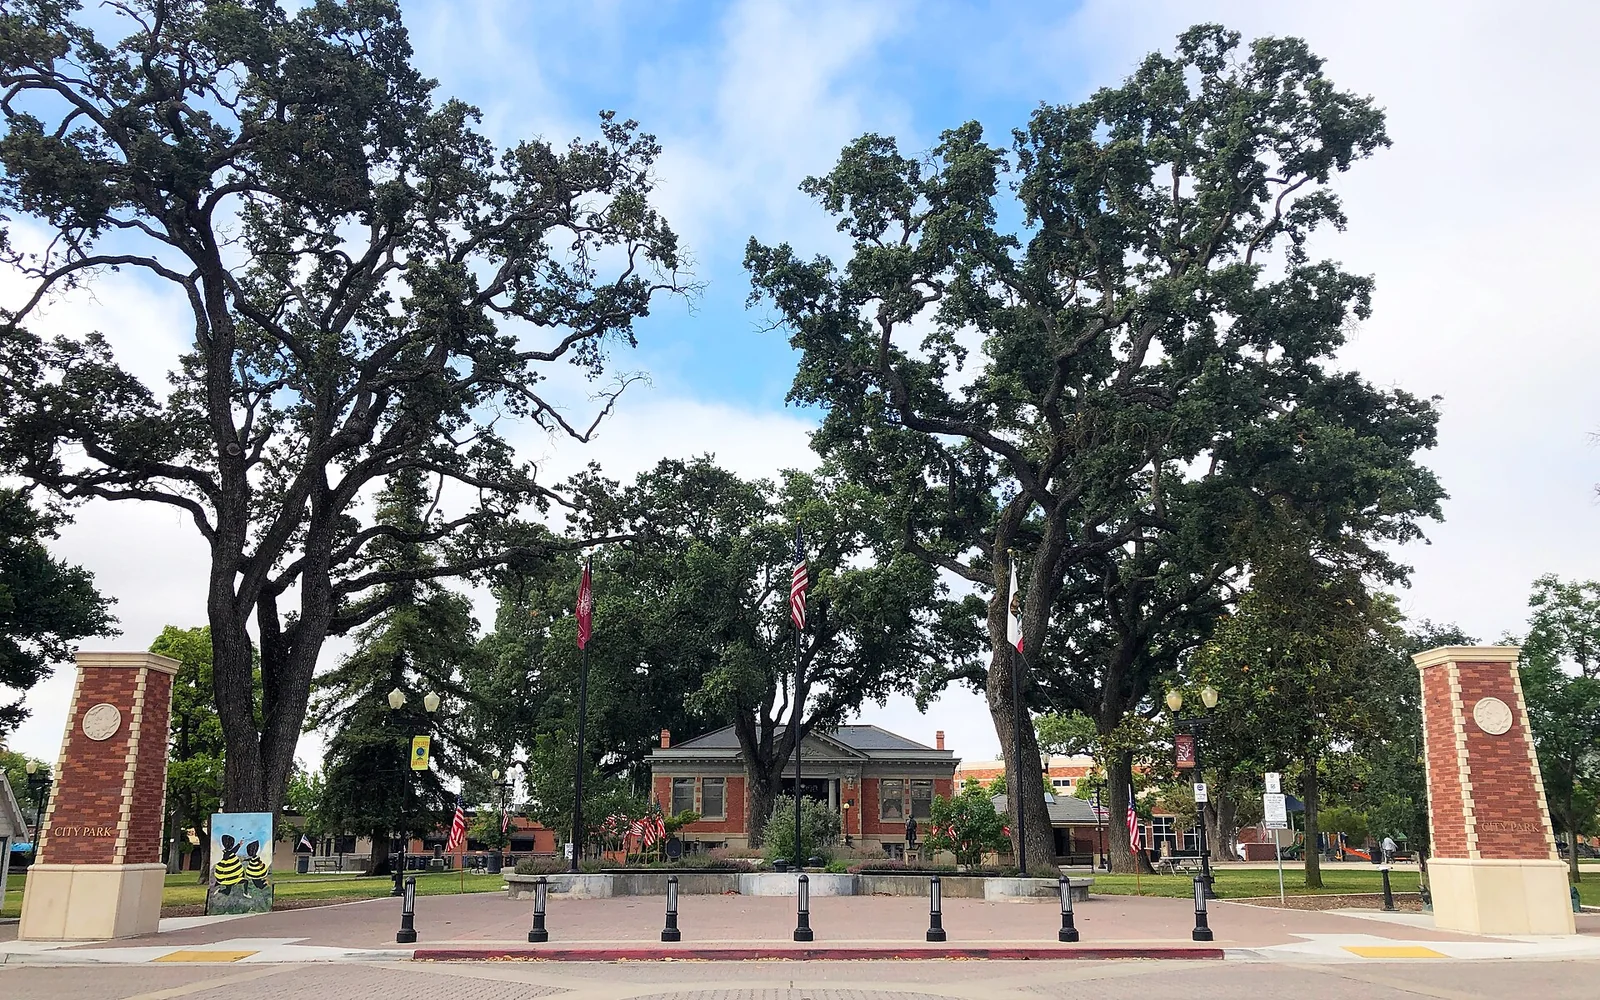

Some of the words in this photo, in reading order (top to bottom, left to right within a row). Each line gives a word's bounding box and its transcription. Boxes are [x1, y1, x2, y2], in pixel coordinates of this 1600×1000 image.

[54, 826, 81, 837] CITY
[82, 826, 112, 837] PARK
[1481, 822, 1508, 832] CITY
[1510, 822, 1540, 833] PARK
